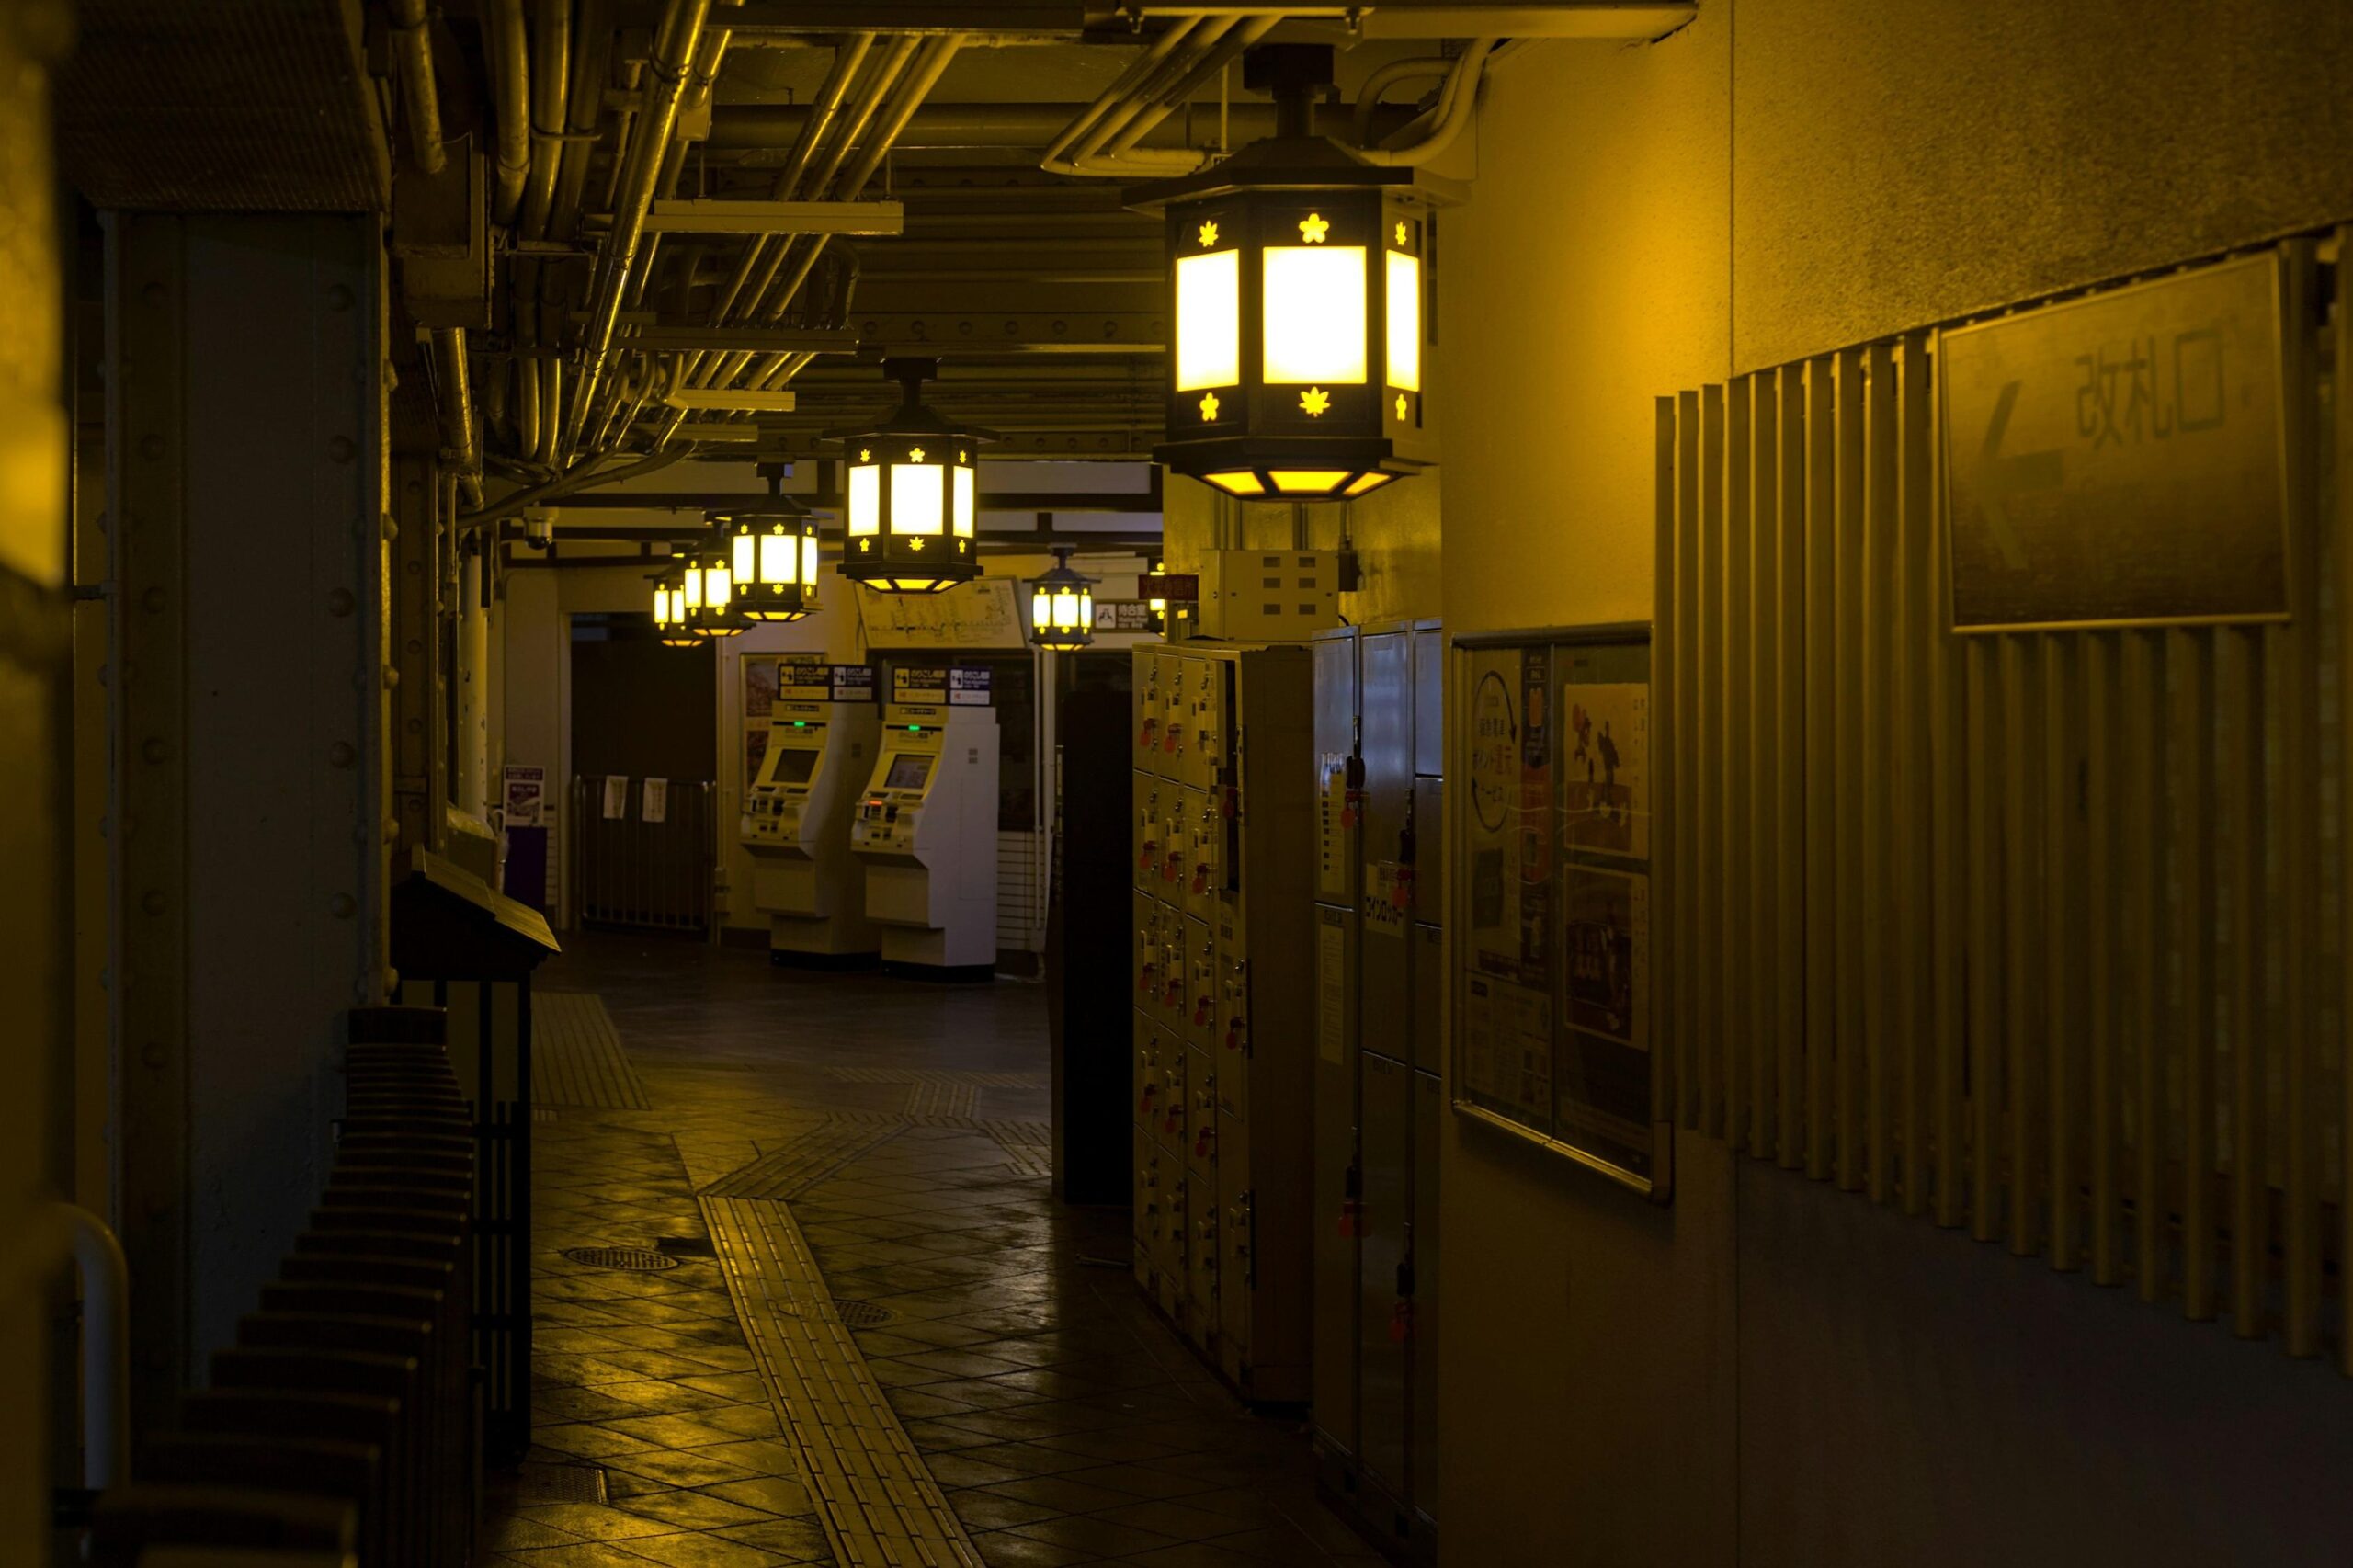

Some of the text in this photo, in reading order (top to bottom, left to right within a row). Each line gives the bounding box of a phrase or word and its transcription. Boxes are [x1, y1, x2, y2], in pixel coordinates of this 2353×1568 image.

[2075, 328, 2225, 449] 改札口
[1366, 896, 1403, 926] コインロッカー
